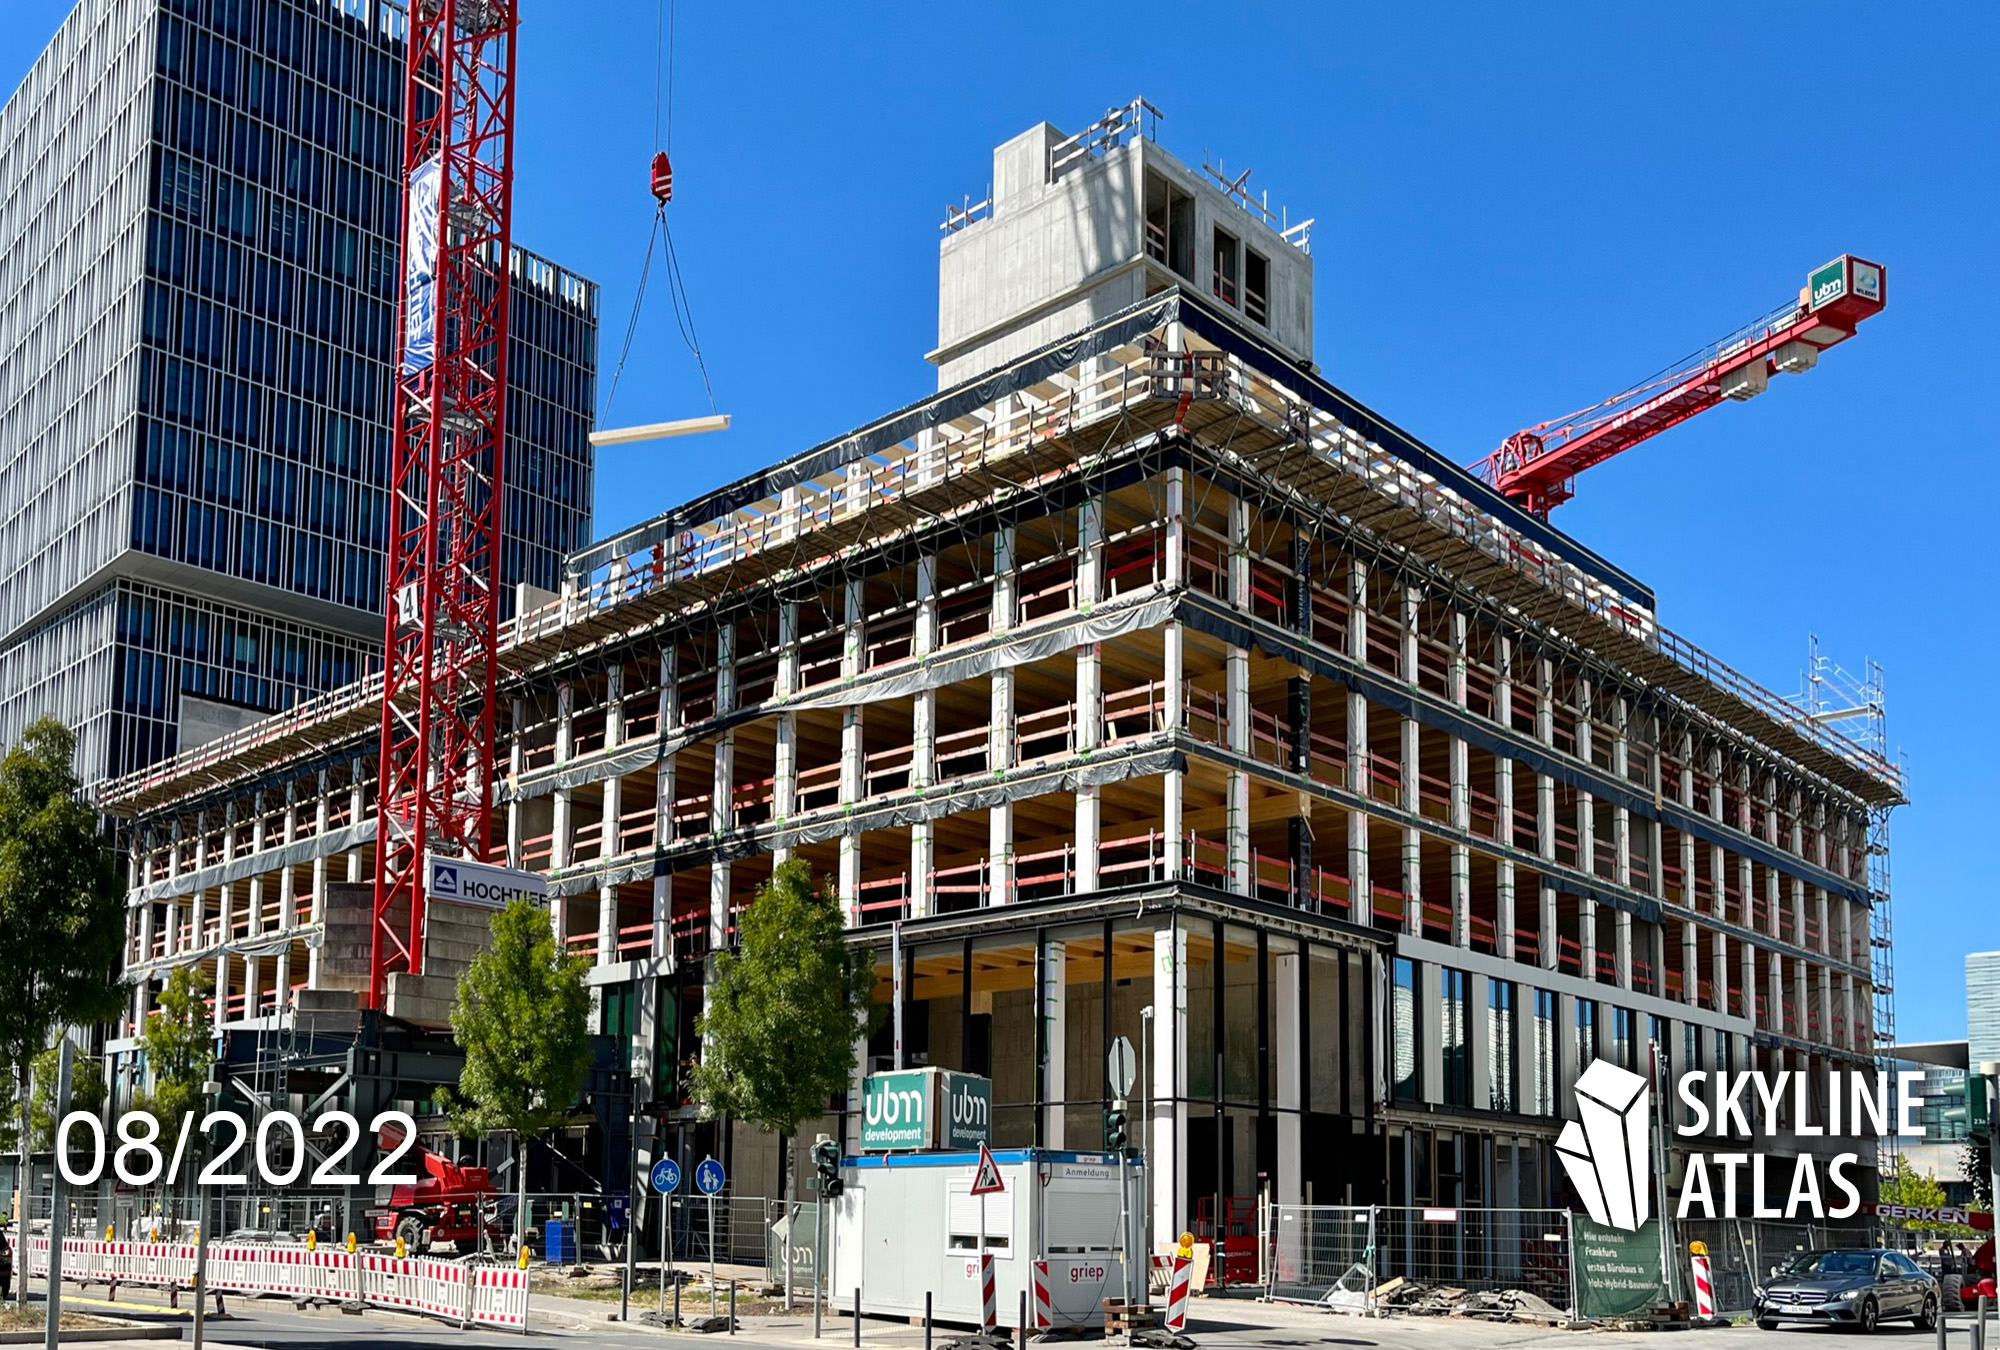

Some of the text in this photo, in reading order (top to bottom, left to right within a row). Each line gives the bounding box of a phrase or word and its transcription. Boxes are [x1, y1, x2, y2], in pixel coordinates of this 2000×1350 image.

[1814, 279, 1841, 300] ubm
[403, 586, 414, 618] 4
[463, 880, 548, 909] HOCHTIEF
[866, 1081, 923, 1126] ubm
[953, 1084, 987, 1126] ubm
[865, 1128, 922, 1143] development
[952, 1126, 987, 1141] development
[1065, 1168, 1110, 1179] Anmeldung
[1875, 1204, 1970, 1224] GERKEN
[1585, 1246, 1618, 1258] Frankfurts
[781, 1264, 813, 1273] dlopment
[966, 1260, 980, 1278] gri
[1070, 1262, 1104, 1282] griep
[1586, 1262, 1645, 1274] erstes Bürohaus in
